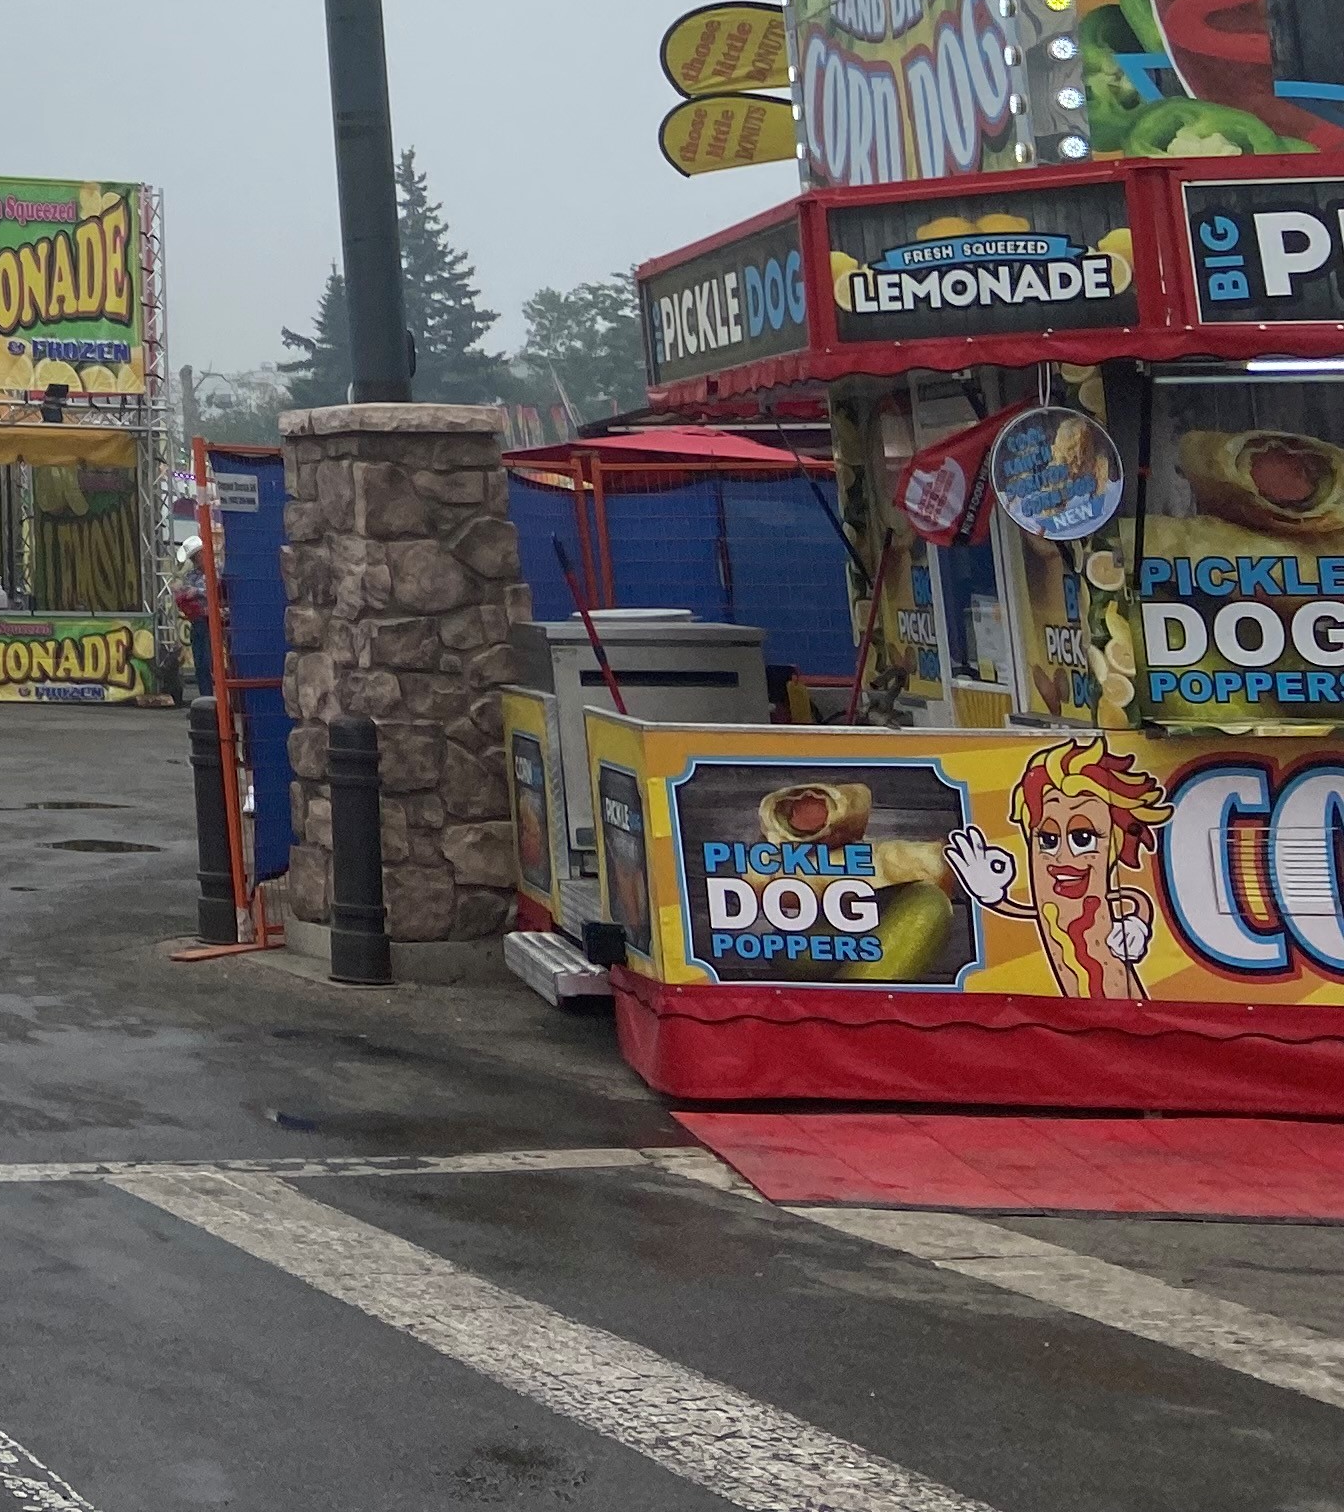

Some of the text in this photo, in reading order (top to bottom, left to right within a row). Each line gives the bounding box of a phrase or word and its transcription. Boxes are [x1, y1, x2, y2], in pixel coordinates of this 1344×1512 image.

[4, 194, 78, 225] Squeezed
[903, 239, 1049, 265] FRESH SQUEEZED
[1199, 215, 1250, 301] BIG
[849, 258, 1112, 314] LEMONADE
[660, 271, 744, 363] PICKLE
[744, 250, 805, 338] DOG
[32, 339, 131, 363] FROZEN
[1051, 503, 1095, 530] NEW
[1140, 556, 1344, 597] PICKLE
[1141, 601, 1344, 667] DOG
[1149, 670, 1344, 704] POPPER
[703, 841, 875, 876] PICKLE
[706, 877, 880, 933] DOG
[712, 933, 883, 961] POPPERS
